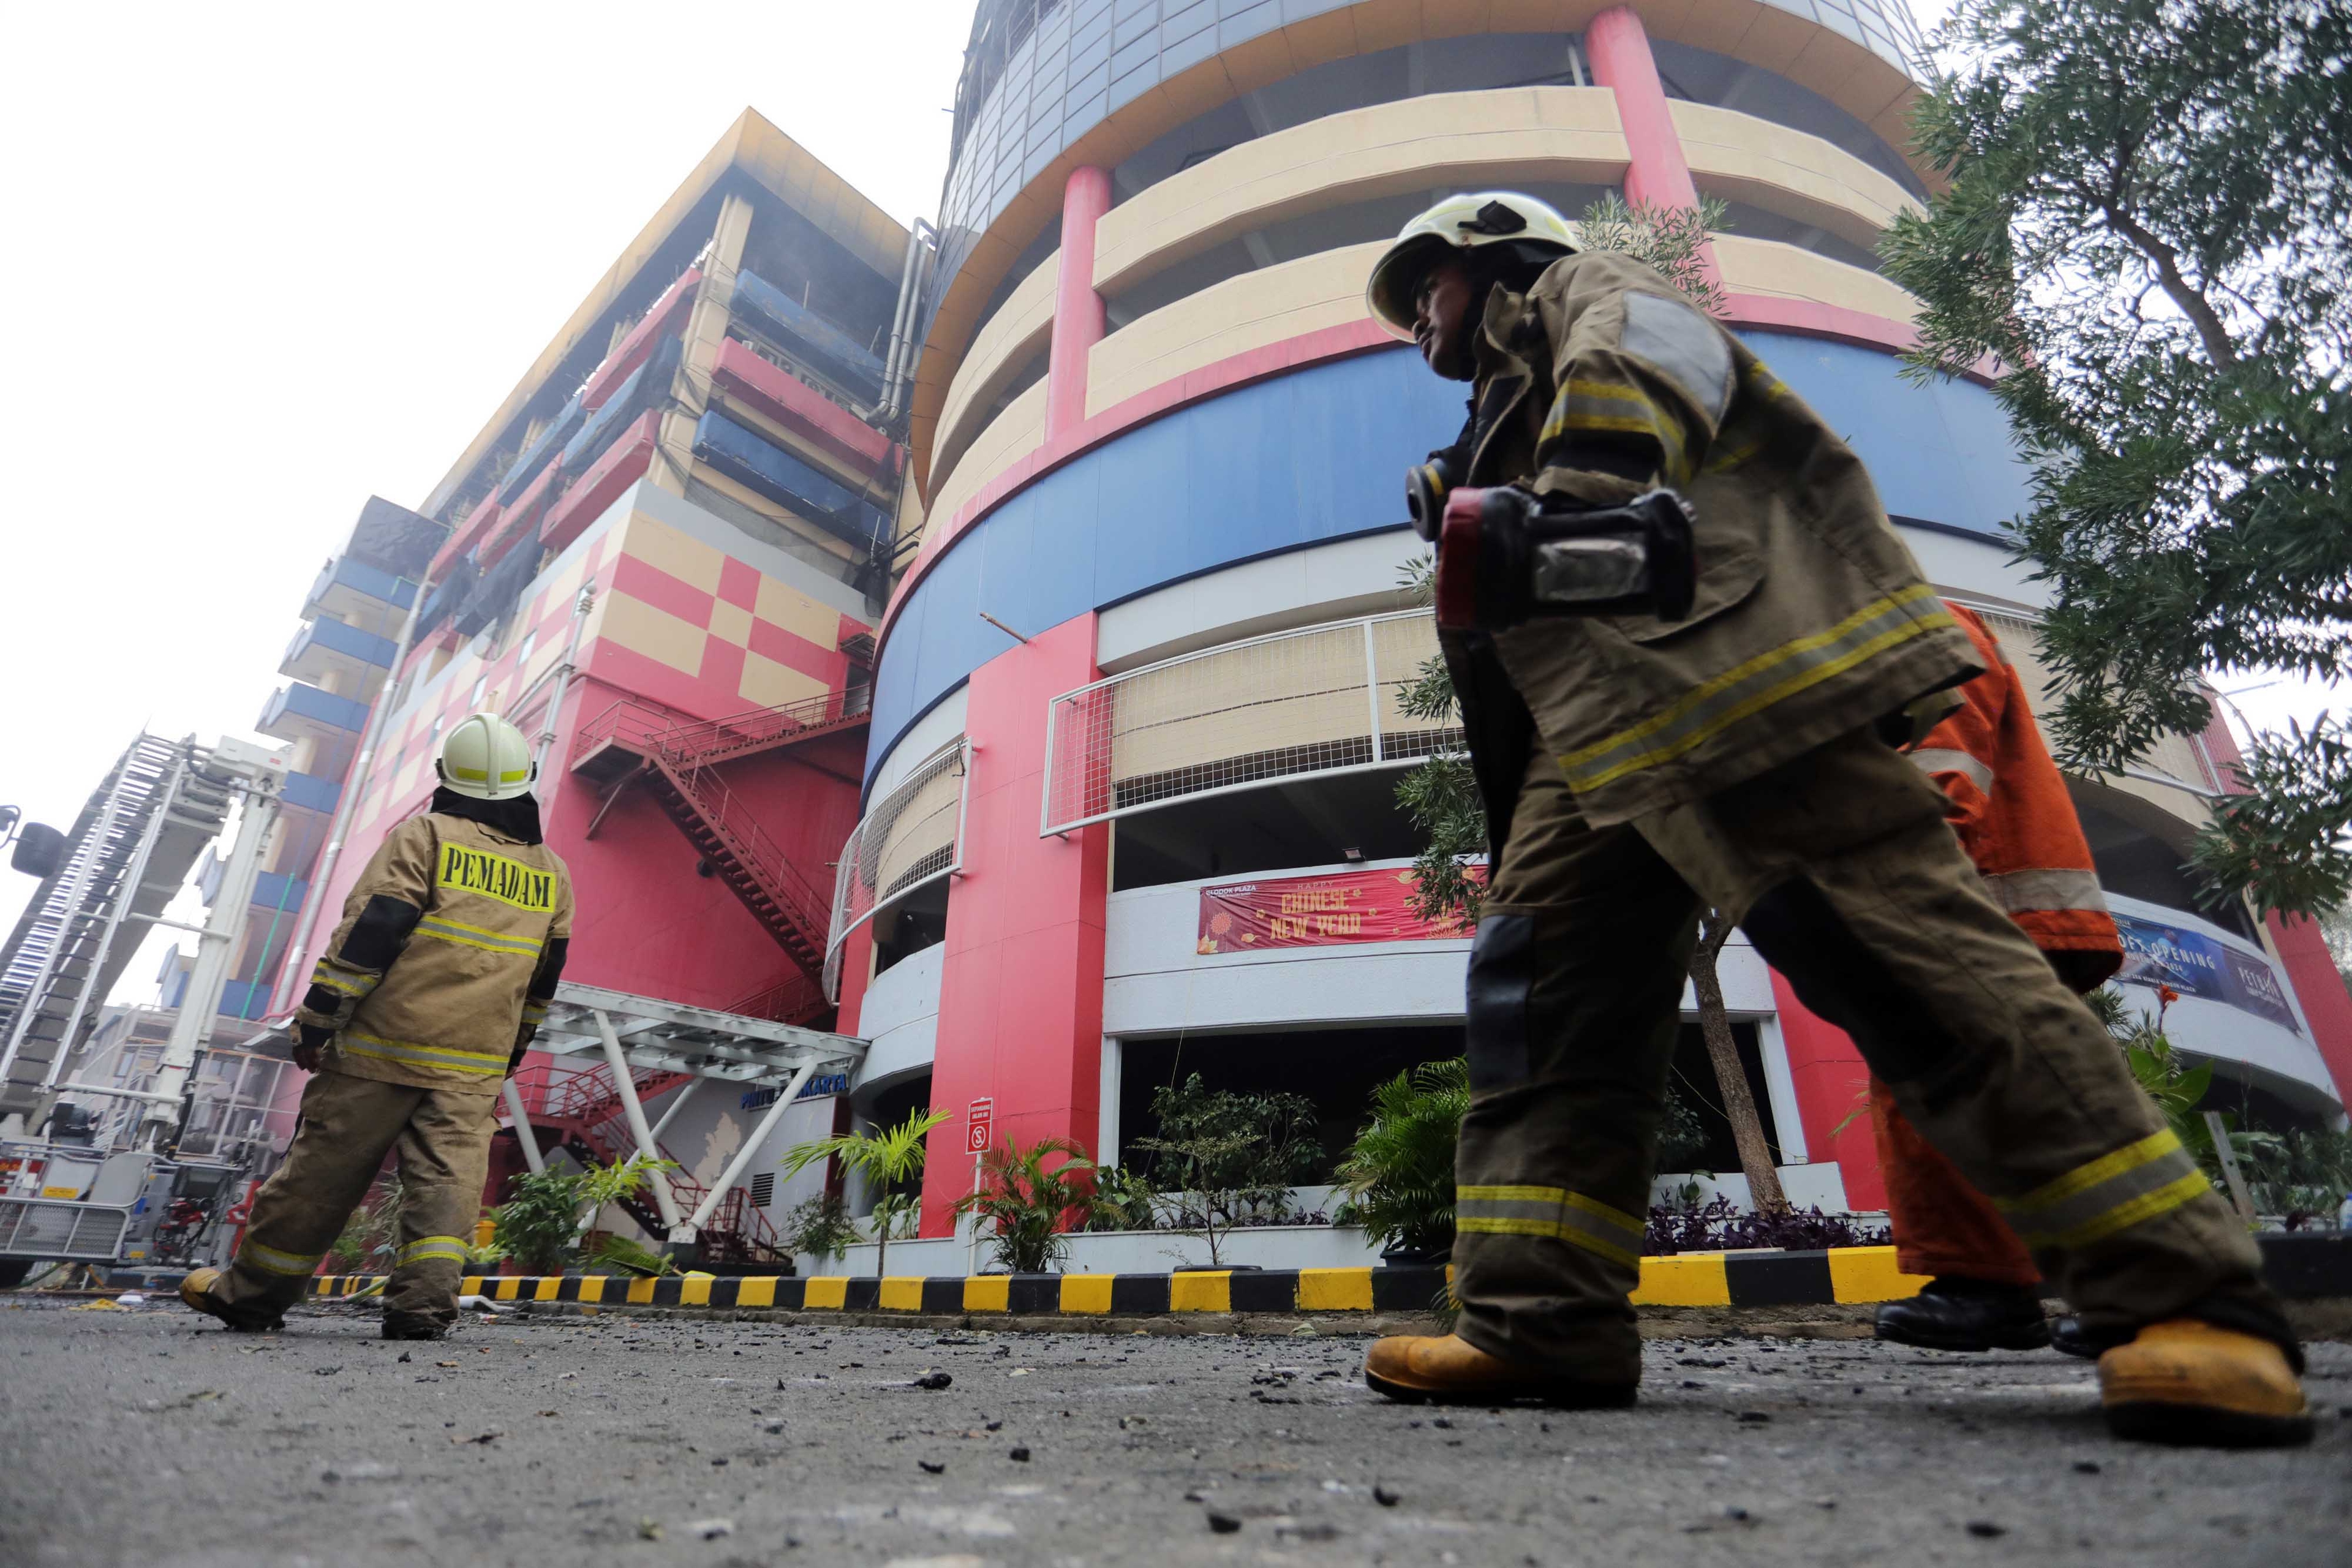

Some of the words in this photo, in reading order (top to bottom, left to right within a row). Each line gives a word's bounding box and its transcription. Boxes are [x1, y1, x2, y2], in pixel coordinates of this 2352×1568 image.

[443, 847, 550, 908] PEMADAM
[1281, 889, 1350, 914] CHINESE
[1270, 917, 1310, 940] NEW
[1317, 913, 1361, 937] YEAR
[2116, 933, 2144, 951] OFT
[2151, 942, 2215, 969] OPENING
[741, 1088, 775, 1109] PINTU
[796, 1074, 848, 1098] KARTA
